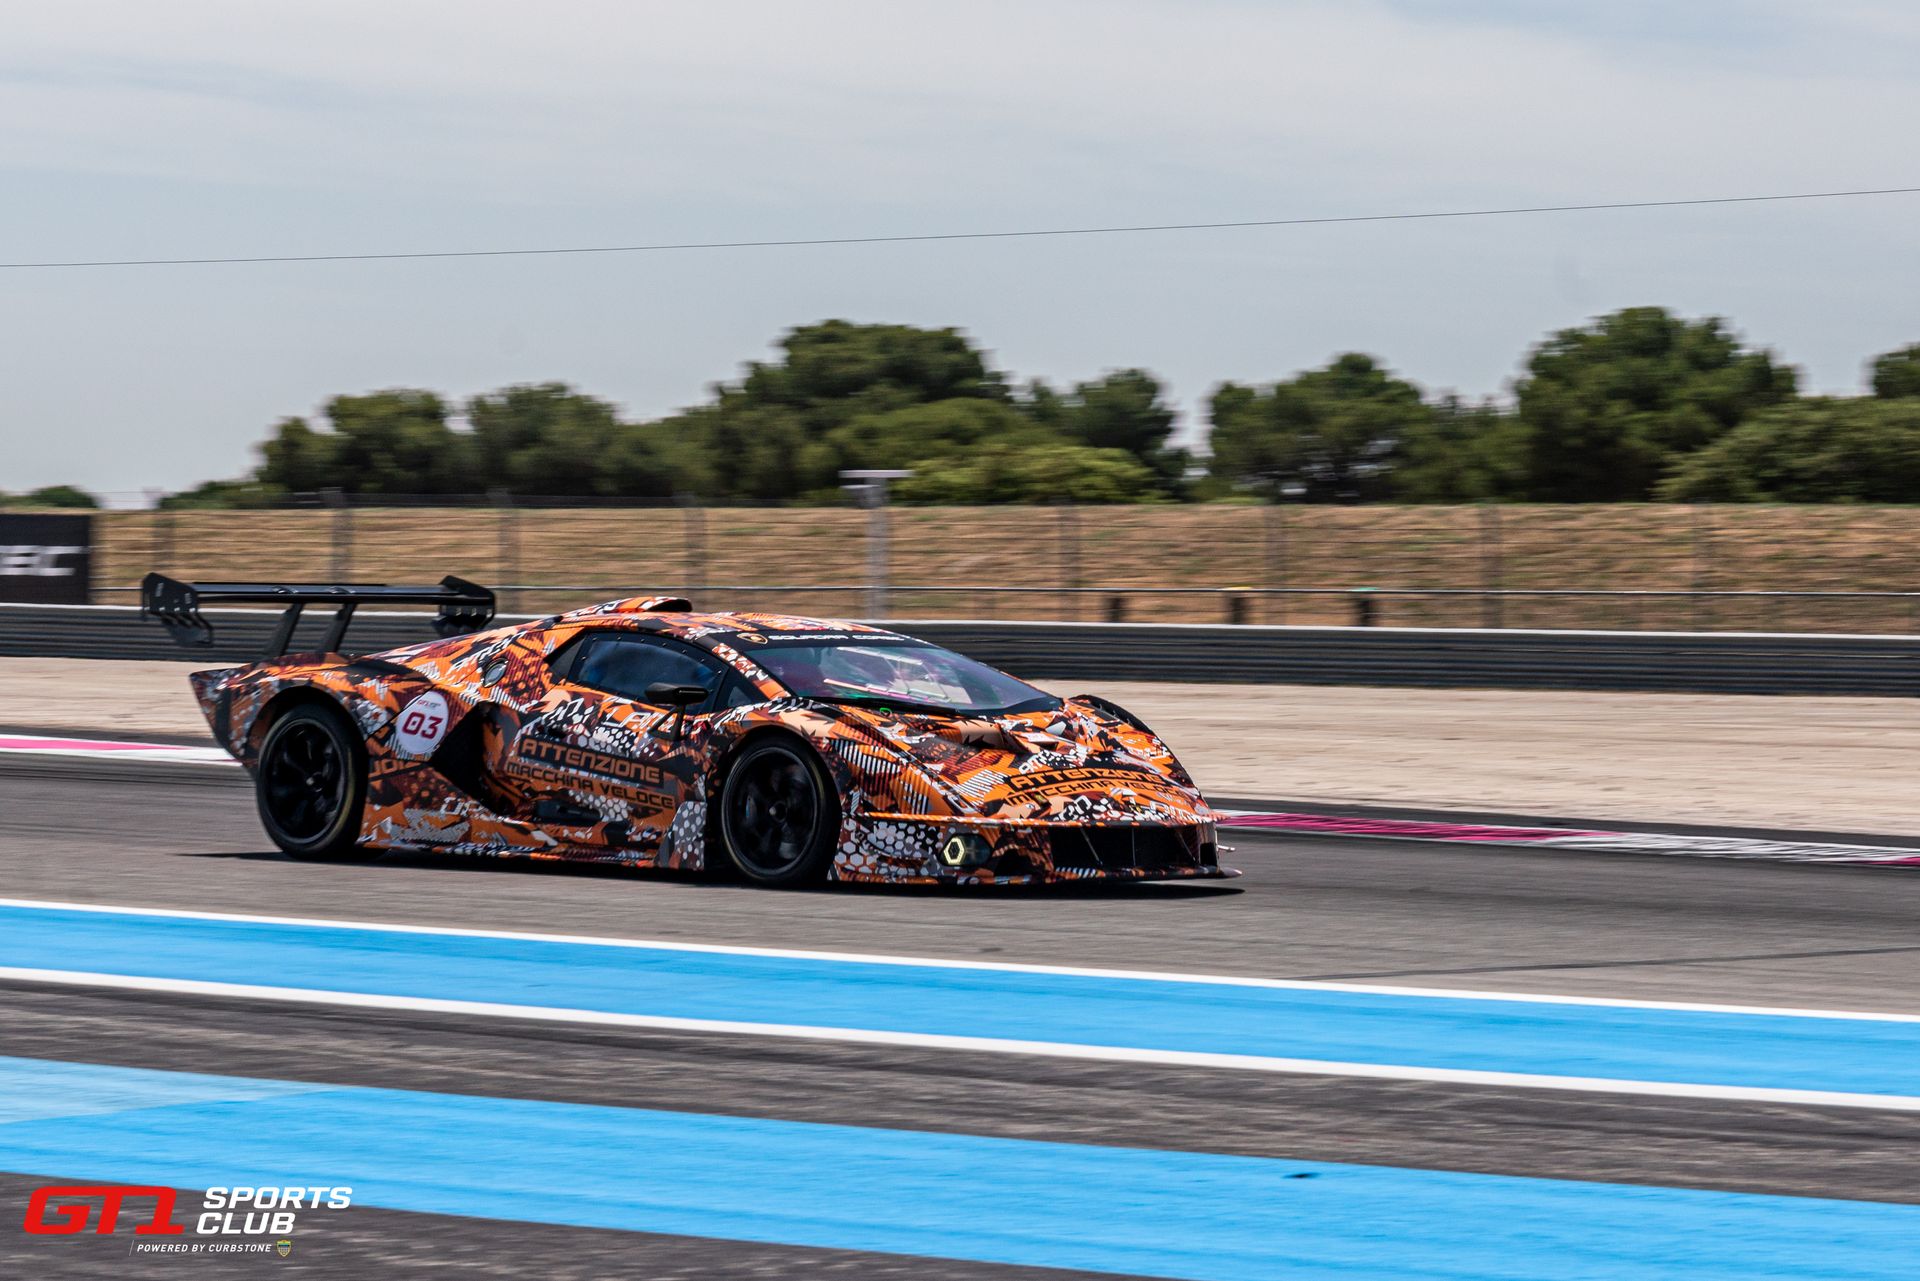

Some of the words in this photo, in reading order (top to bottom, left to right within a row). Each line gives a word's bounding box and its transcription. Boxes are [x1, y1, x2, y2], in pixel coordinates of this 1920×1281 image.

[402, 711, 443, 740] 03
[522, 738, 661, 784] ATTENZIONE
[1010, 767, 1166, 789] ATTENZIONE
[506, 761, 594, 792] MACCHINA
[600, 783, 674, 809] VELOCE
